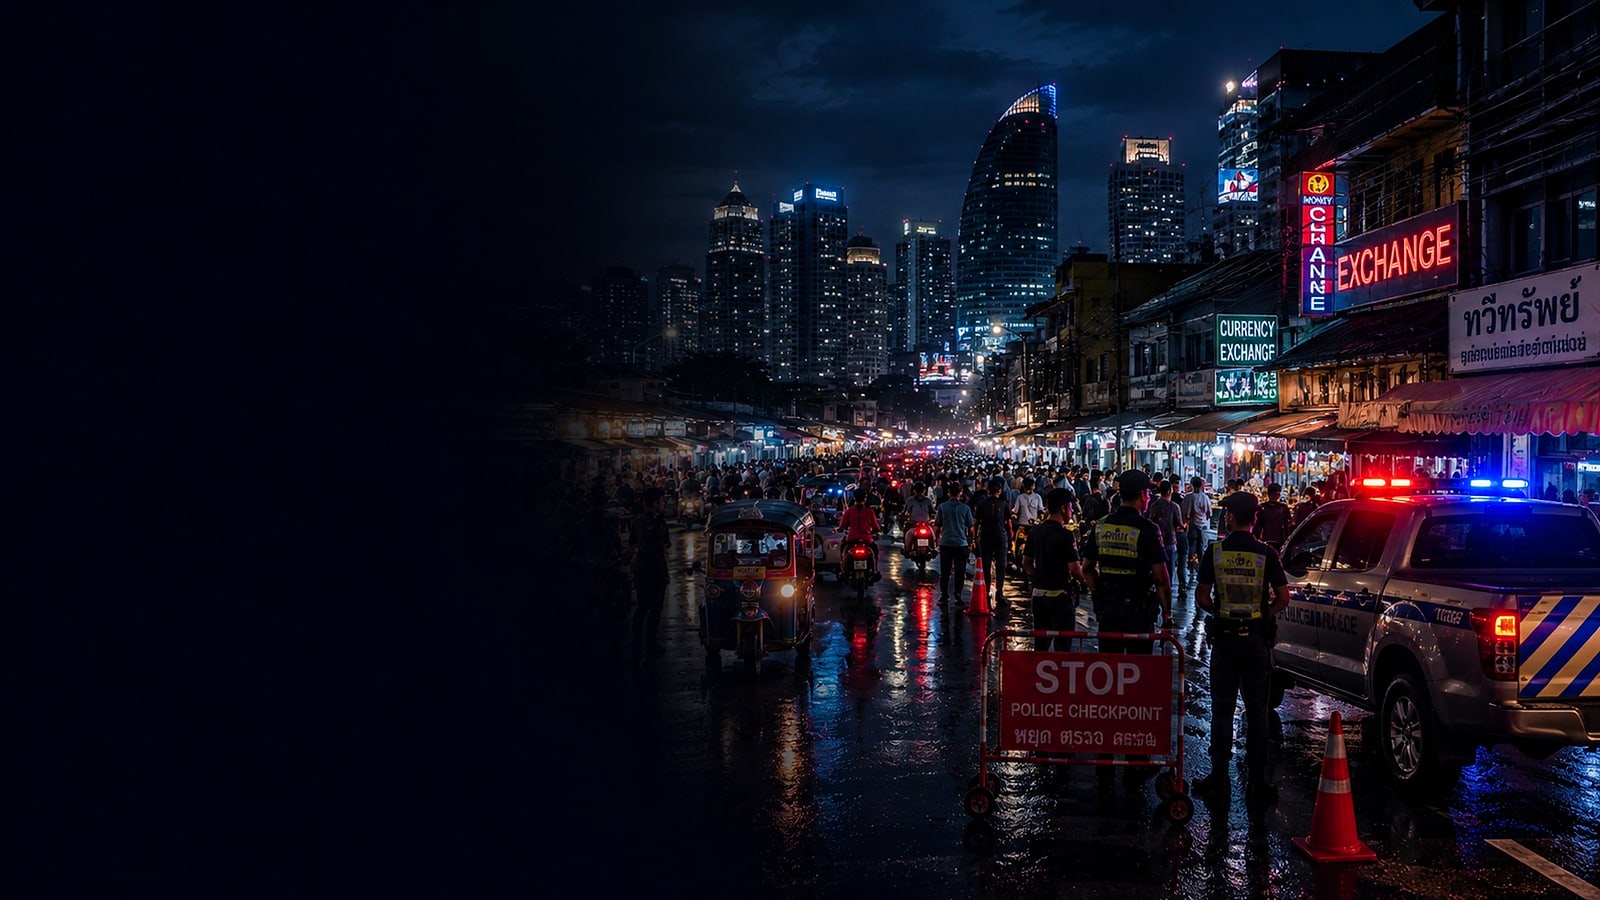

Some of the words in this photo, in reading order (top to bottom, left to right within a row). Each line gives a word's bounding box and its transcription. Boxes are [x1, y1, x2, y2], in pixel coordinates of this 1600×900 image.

[1337, 224, 1451, 292] EXCHANGE
[1220, 320, 1275, 337] CURRENCY
[1220, 343, 1275, 361] EXCHANGE
[1035, 660, 1140, 695] STOP
[1011, 703, 1063, 718] POLICE
[1068, 704, 1163, 721] CHECKPOINT
